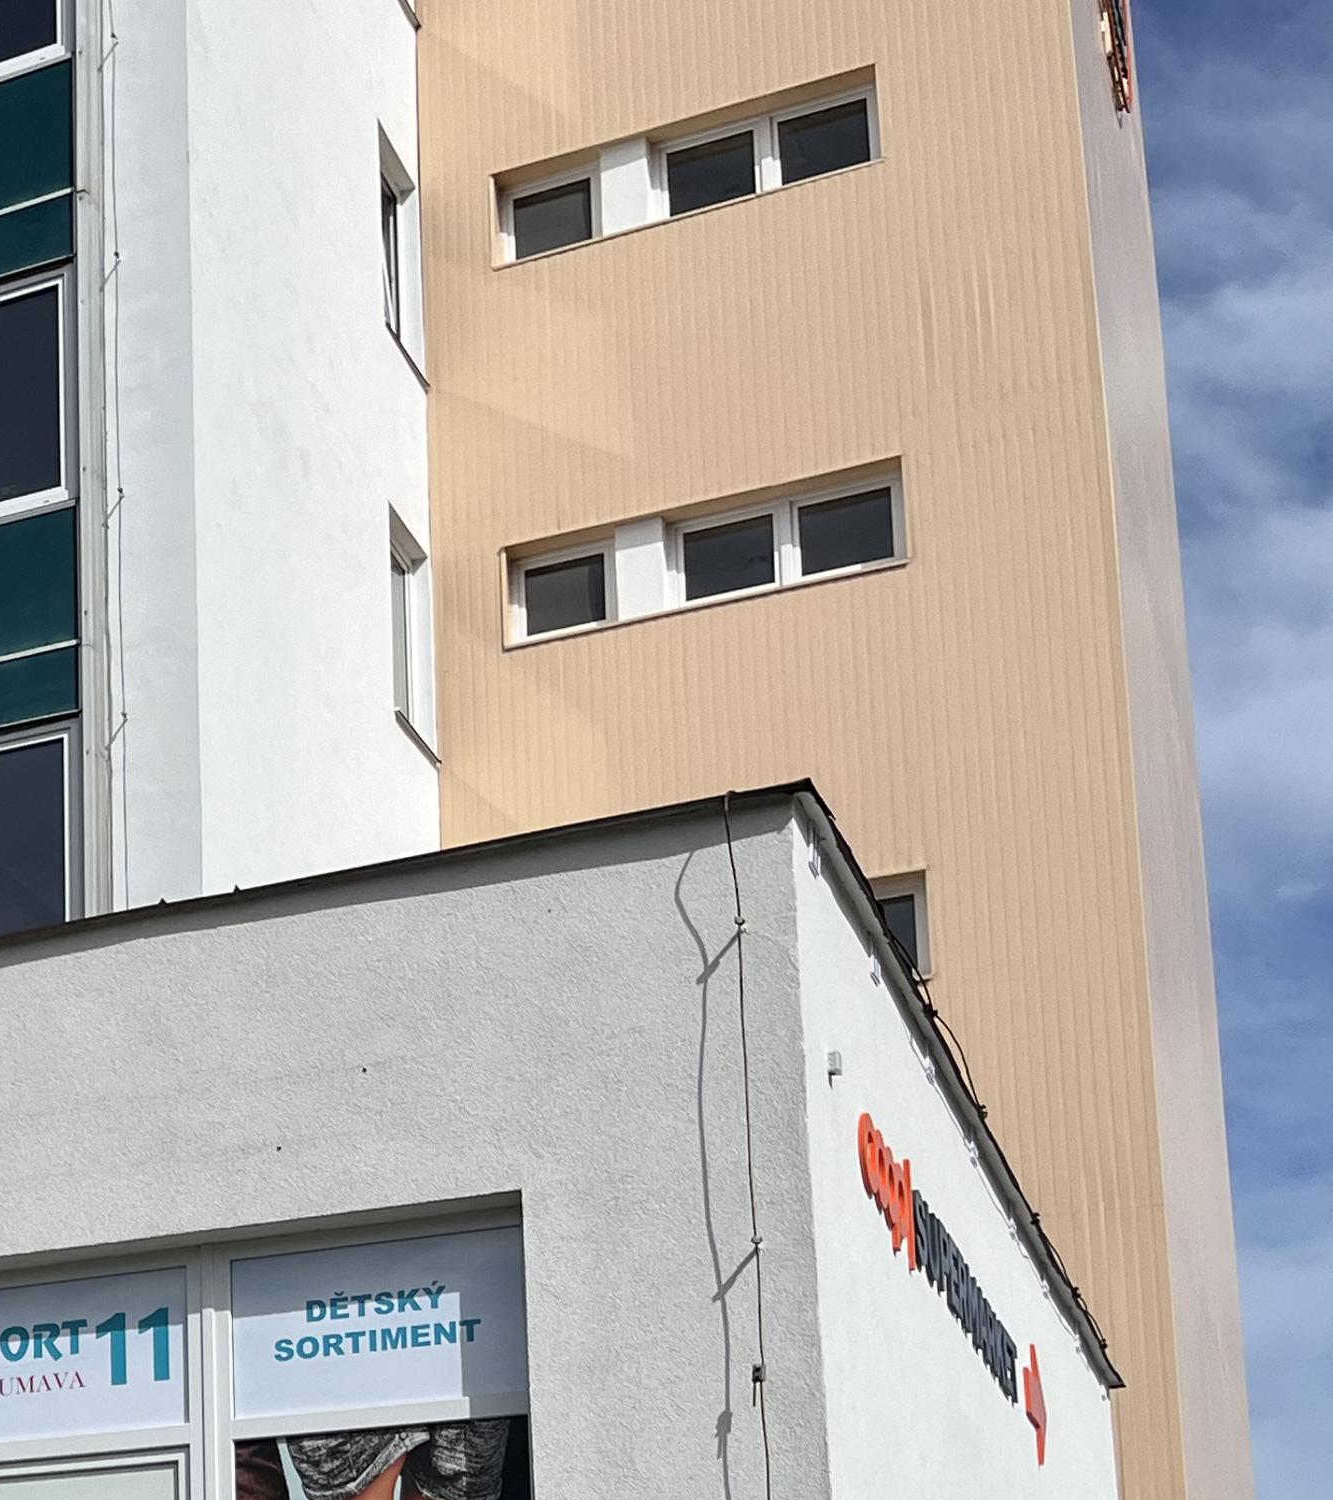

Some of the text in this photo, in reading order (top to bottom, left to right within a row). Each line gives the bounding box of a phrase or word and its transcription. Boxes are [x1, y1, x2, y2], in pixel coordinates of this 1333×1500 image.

[305, 1280, 446, 1323] DĚTSKÝ
[95, 1307, 170, 1386] 11
[273, 1318, 482, 1363] SORTIMENT
